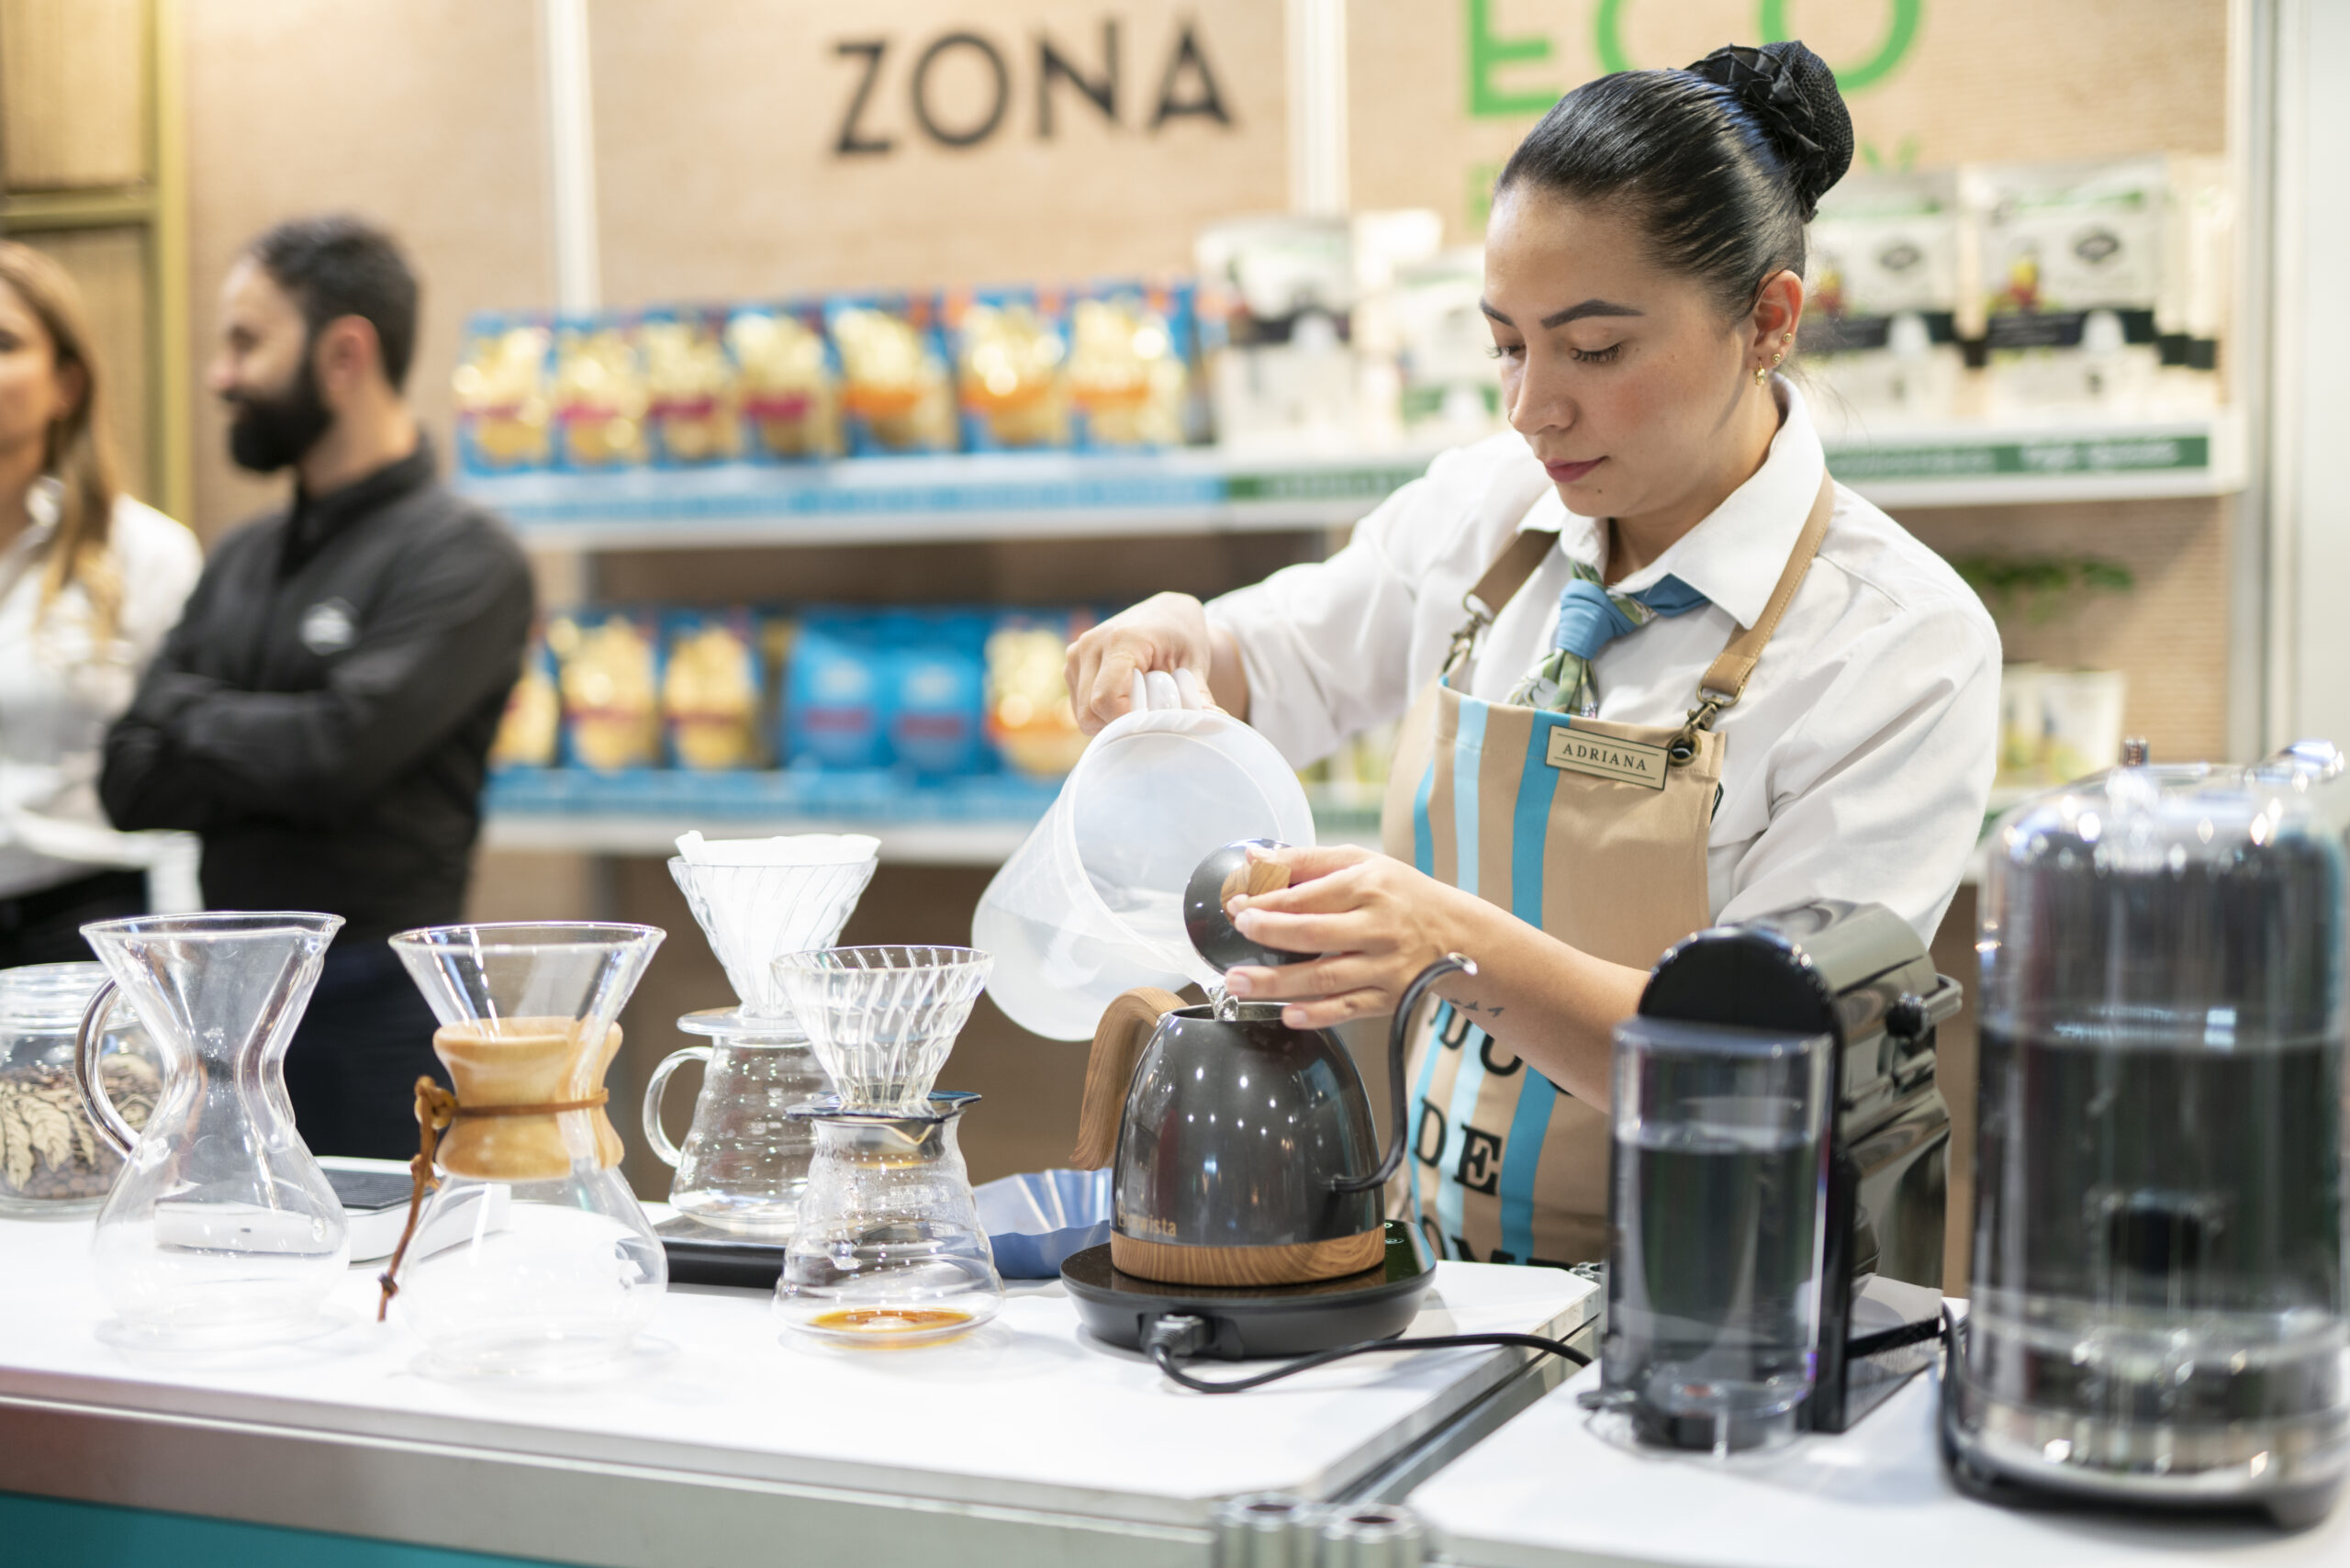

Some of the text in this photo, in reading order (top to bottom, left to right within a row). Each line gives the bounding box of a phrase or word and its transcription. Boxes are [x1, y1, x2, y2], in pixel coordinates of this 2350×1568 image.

[829, 17, 1236, 157] ZONA
[1563, 744, 1646, 770] ADRIANA
[1414, 1097, 1503, 1196] DE
